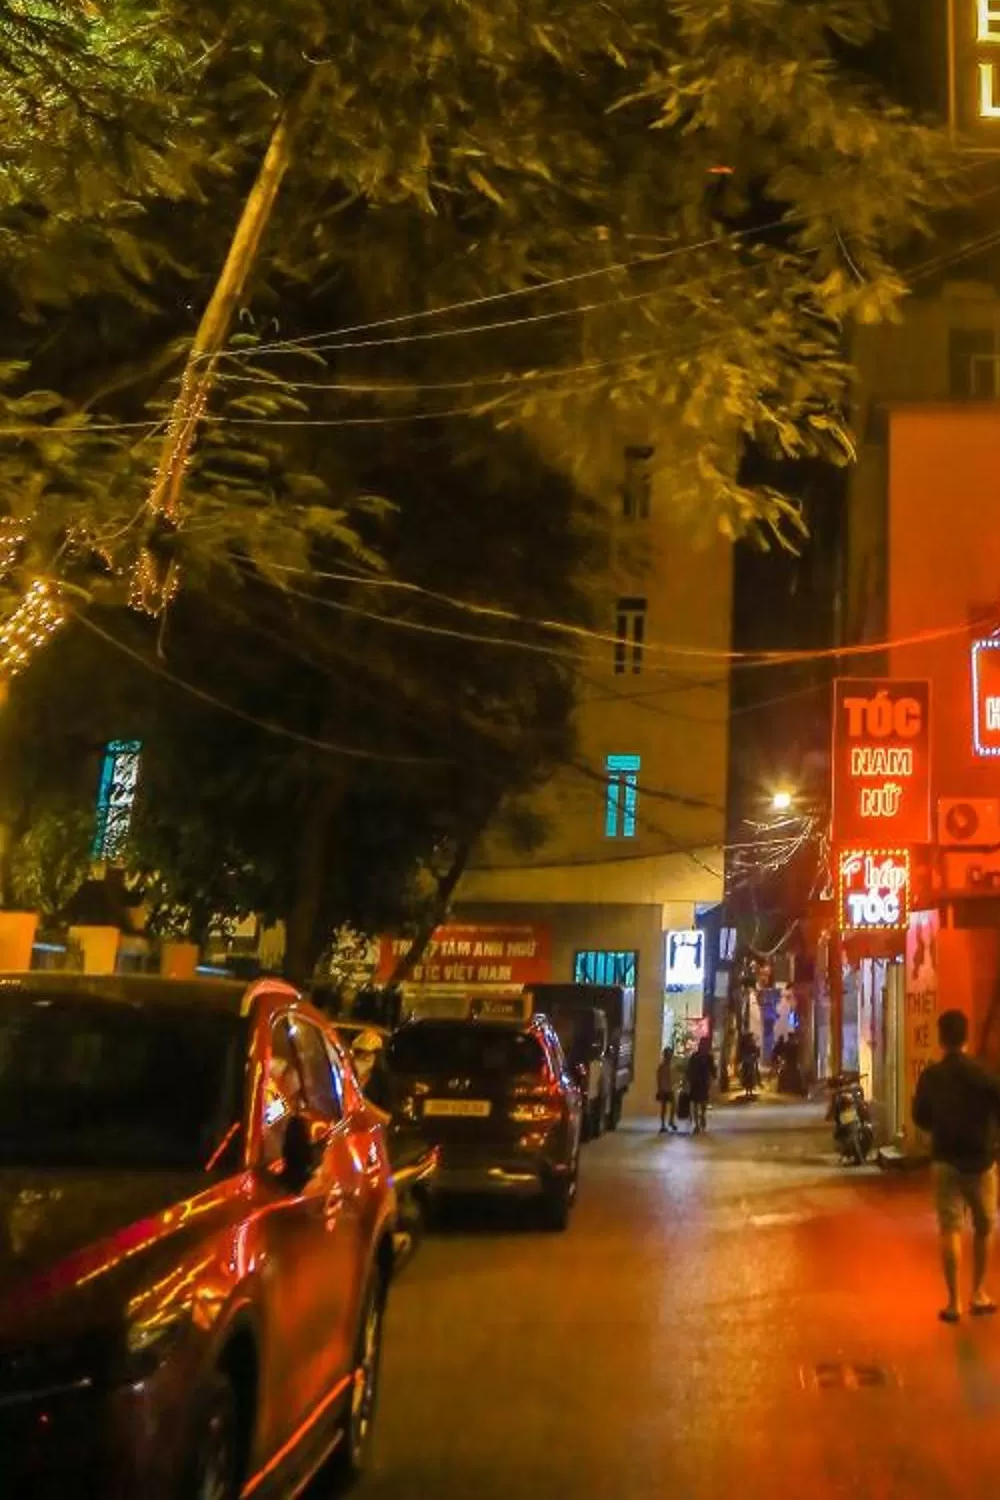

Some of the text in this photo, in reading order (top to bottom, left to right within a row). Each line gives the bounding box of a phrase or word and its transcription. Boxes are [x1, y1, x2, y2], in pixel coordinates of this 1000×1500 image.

[843, 690, 921, 738] TÓC
[851, 747, 912, 775] NAM
[860, 782, 902, 817] NỮ
[848, 887, 899, 924] TÓC
